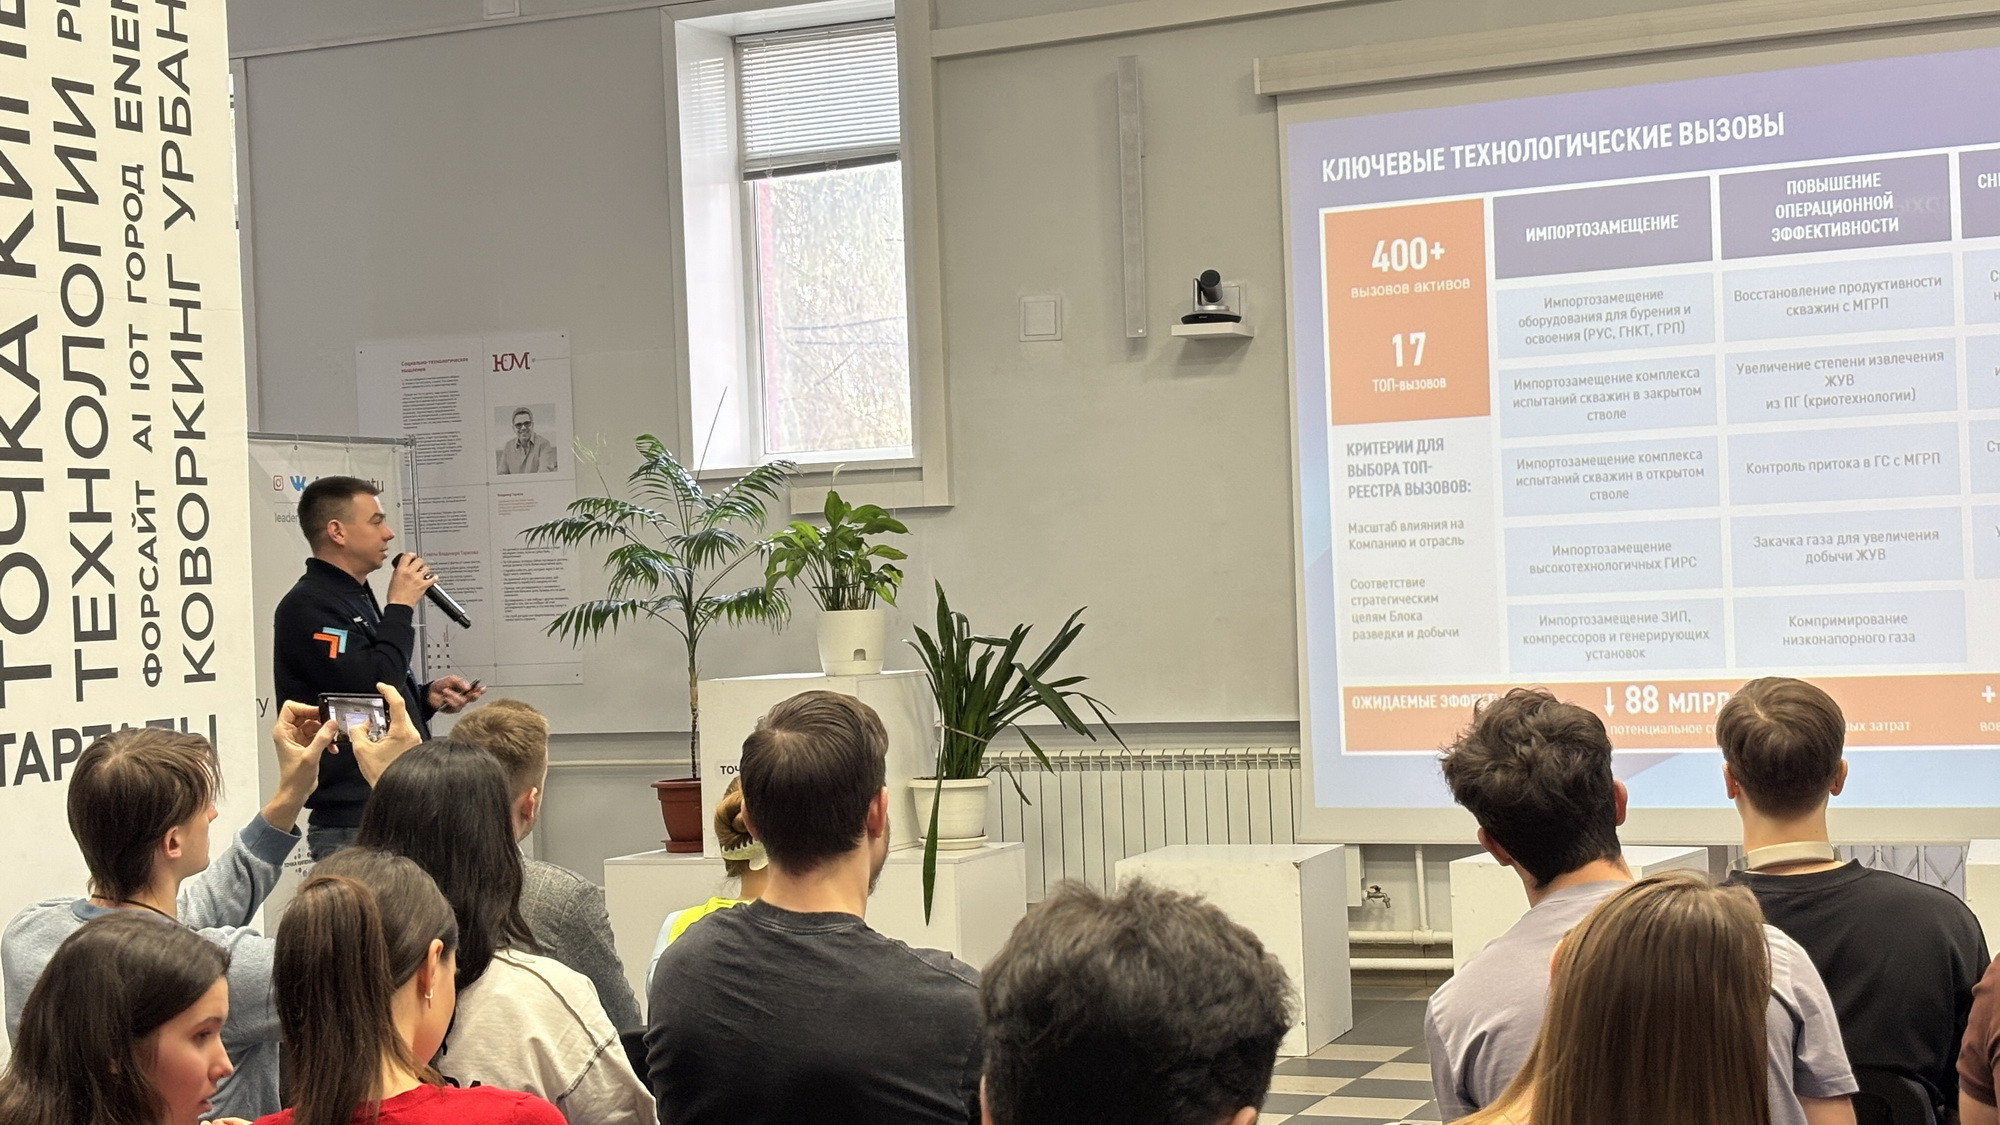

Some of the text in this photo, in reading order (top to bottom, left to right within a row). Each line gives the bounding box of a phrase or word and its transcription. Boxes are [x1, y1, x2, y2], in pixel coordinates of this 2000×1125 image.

[110, 0, 143, 133] ENE
[1322, 111, 1785, 183] КЛЮЧЕВЫЕ ТЕХНОЛОГИЧЕСКИЕ ВЫЗОВЫ
[1786, 172, 1882, 195] ПОВЫШЕНИЕ
[1977, 173, 2000, 188] СН
[1775, 191, 1894, 220] ОПЕРАЦИОННОЙ
[121, 163, 147, 303] ГОРОД
[1526, 214, 1679, 242] ИМПОРТОЗАМЕЩЕНИЕ
[1771, 217, 1899, 242] ЭФФЕКТИВНОСТИ
[1371, 236, 1445, 273] 400+
[1351, 277, 1471, 299] вызовов активов
[1734, 275, 1942, 303] Восстановление продуктивности
[1544, 290, 1664, 309] Импортозамещение
[1786, 297, 1889, 317] скважин с МГРП
[1518, 306, 1691, 329] оборудования для бурения и
[1525, 320, 1685, 345] освоения (РУС, ГНКТ, ГРП)
[1392, 332, 1426, 367] 17
[1735, 351, 1944, 375] Увеличение степени извлечения
[1372, 378, 1446, 392] ТОП-вызовов
[1514, 367, 1700, 391] Импортозамещение комплекса
[1825, 374, 1855, 387] ЖУВ
[51, 76, 118, 702] ТЕХНОЛОГИИ
[1513, 385, 1702, 408] испытаний скважин в закрытом
[1766, 387, 1916, 409] из ПГ (криотехнологии)
[1587, 409, 1627, 421] стволе
[132, 414, 153, 453] AI
[1347, 438, 1444, 456] КРИТЕРИИ ДЛЯ
[166, 253, 216, 683] КОВОРКИНГ
[1348, 461, 1432, 477] ВЫБОРА ТОП-
[1516, 449, 1703, 471] Импортозамещение комплекса
[1746, 452, 1940, 475] Контроль притока в ГС с МГРП
[1516, 467, 1704, 487] испытаний скважин в открытом
[1349, 480, 1471, 498] РЕЕСТРА ВЫЗОВОВ:
[1589, 489, 1629, 501] стволе
[0, 314, 52, 708] ТОЧКА
[1348, 520, 1464, 534] Масштаб влияния на
[1349, 537, 1464, 550] Компанию и отрасль
[1753, 530, 1939, 548] Закачка газа для увеличения
[1552, 541, 1672, 557] Импортозамещение
[1805, 548, 1886, 565] добычи ЖУВ
[1529, 556, 1697, 575] высокотехнологичных ГИРС
[131, 480, 162, 687] ФОРСАЙТ
[1350, 578, 1425, 589] Соответствие
[1351, 595, 1439, 607] стратегическим
[1352, 611, 1422, 624] целям Блока
[1539, 611, 1658, 628] Импортозамещение
[1789, 614, 1908, 629] Компримирование
[1353, 627, 1459, 641] разведки и добычи
[1523, 629, 1710, 646] компрессоров и генерирующих
[1783, 632, 1915, 646] низконапорного газа
[1585, 649, 1646, 662] установок
[1352, 694, 1437, 711] ОЖИДАЕМЫЕ
[1625, 685, 1659, 714] 88
[1610, 724, 1702, 736] потенциальное
[1870, 721, 1910, 732] затрат
